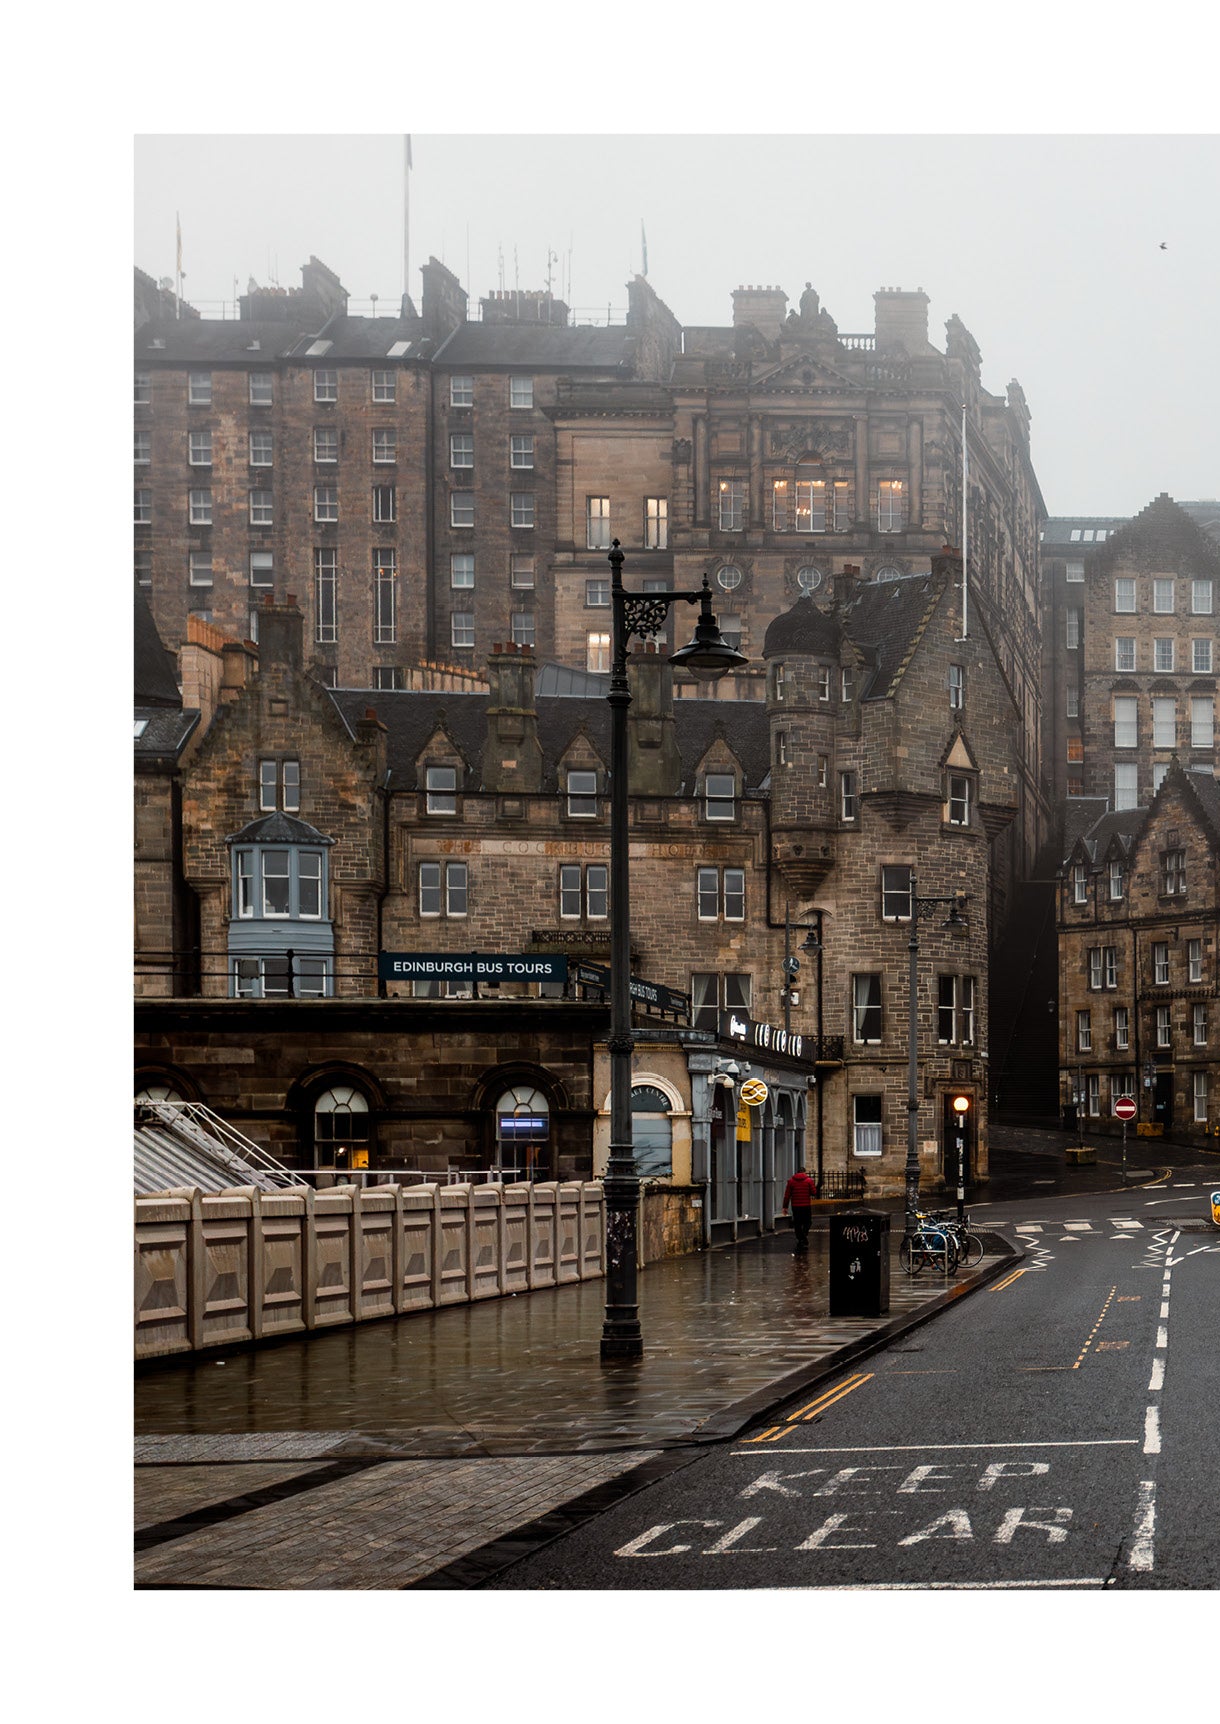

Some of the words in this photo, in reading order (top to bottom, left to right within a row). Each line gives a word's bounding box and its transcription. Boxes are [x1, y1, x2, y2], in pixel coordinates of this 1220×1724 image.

[503, 841, 613, 856] COCKBUR
[393, 961, 473, 974] EDINBURGH
[477, 963, 503, 974] BUS
[507, 963, 553, 975] TOURS
[738, 1461, 1051, 1500] KEEP
[612, 1506, 1075, 1558] CLEAR
